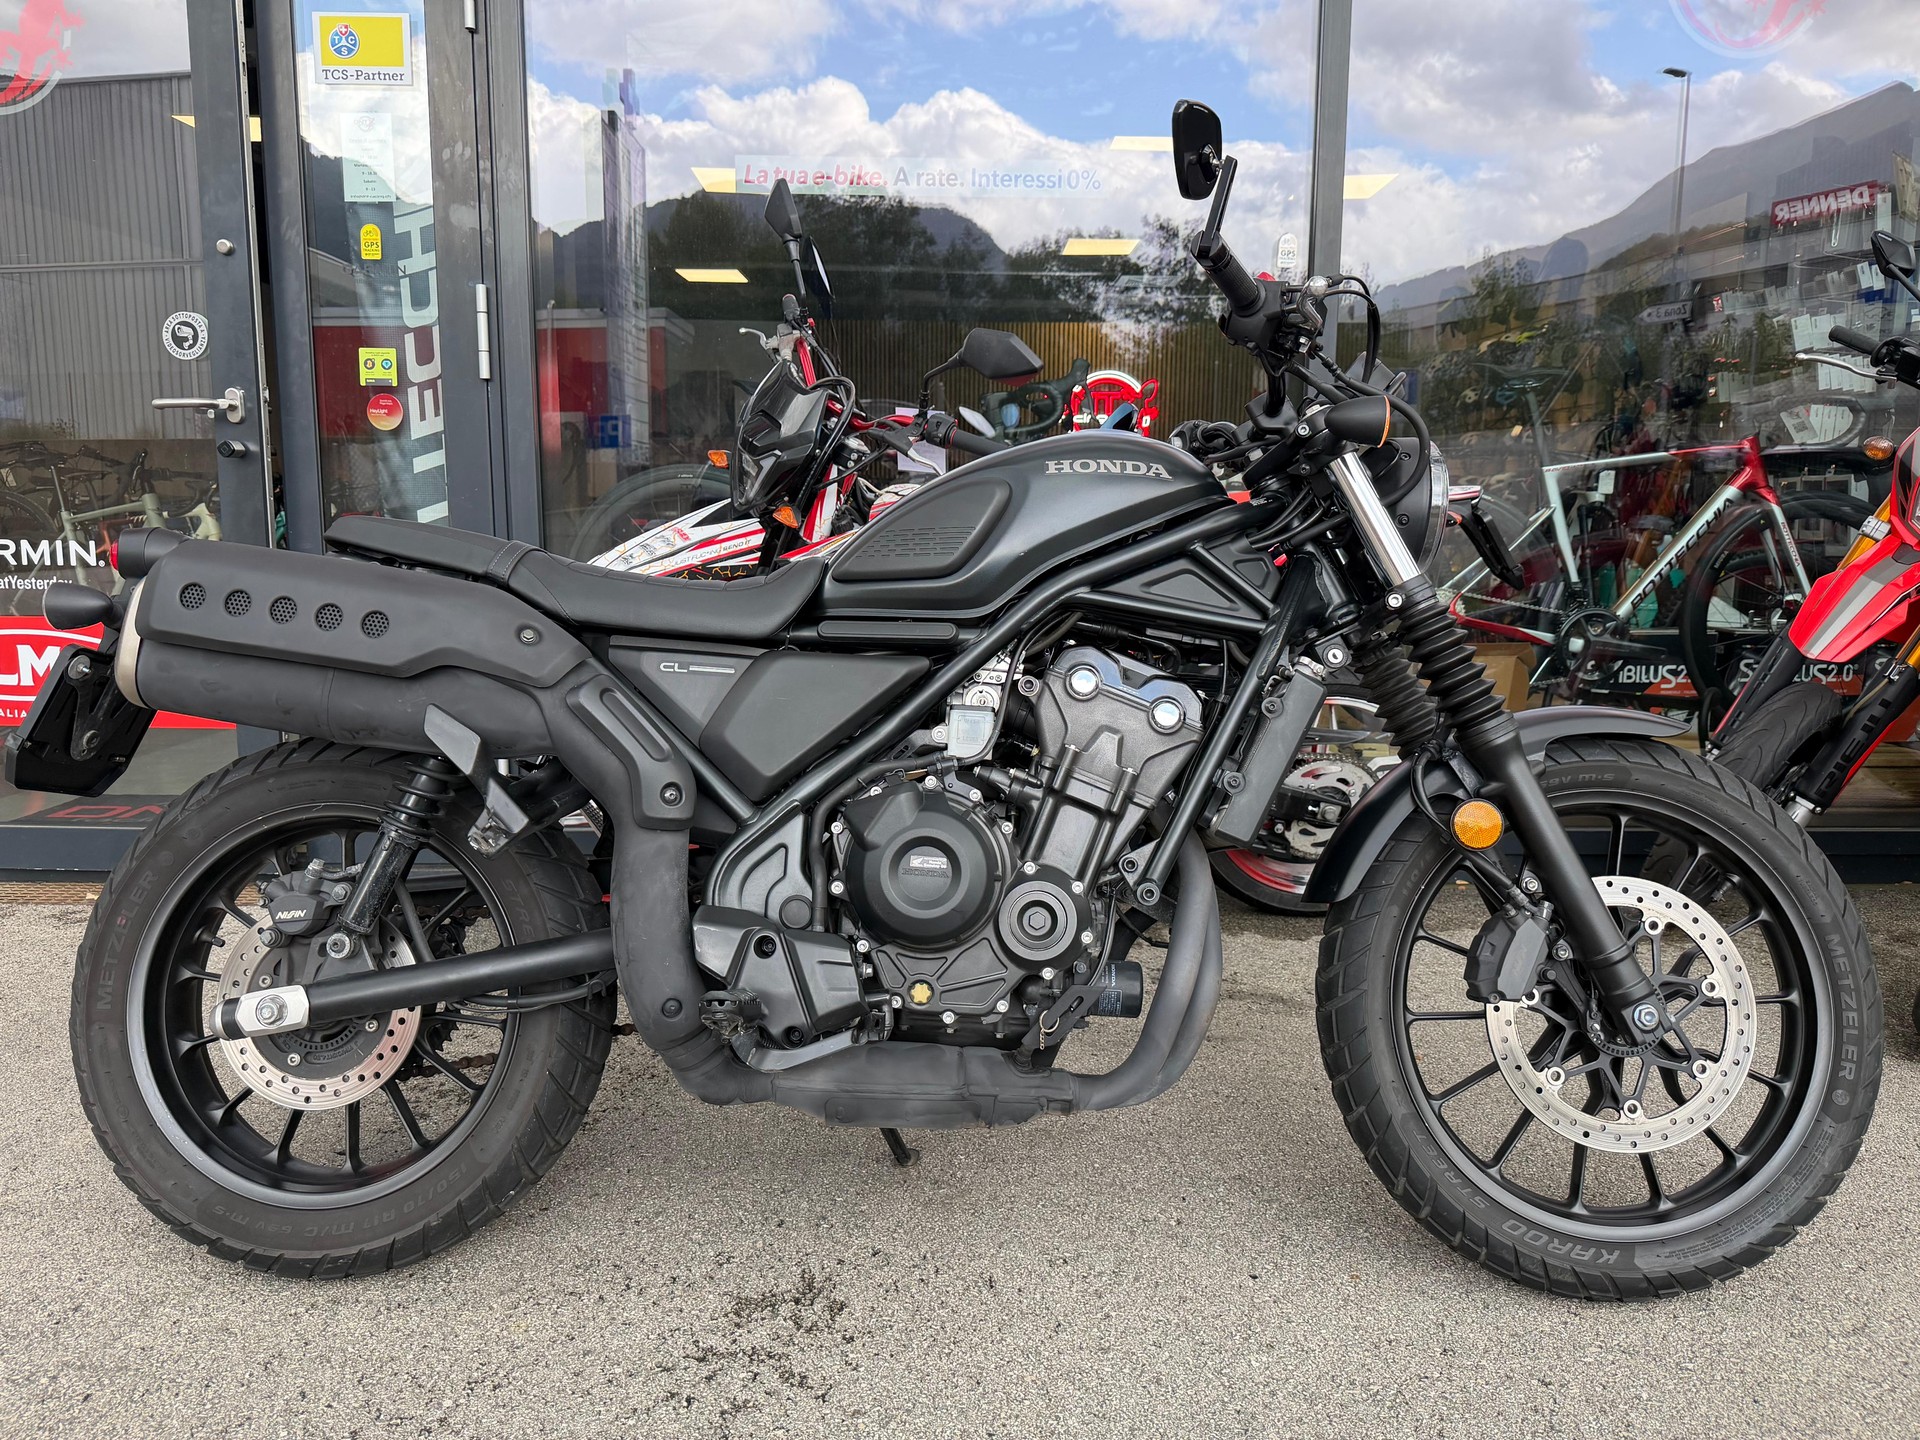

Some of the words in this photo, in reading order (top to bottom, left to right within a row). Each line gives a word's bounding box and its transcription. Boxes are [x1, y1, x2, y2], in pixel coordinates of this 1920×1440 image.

[322, 69, 405, 81] TCS-Partner
[744, 164, 769, 184] La
[812, 164, 889, 187] e-bike.
[893, 166, 910, 187] A
[916, 169, 965, 187] rate.
[971, 167, 1062, 189] Interessi
[1066, 169, 1101, 190] 0%
[164, 336, 206, 358] VIDEOSORVEGLIANZA
[1045, 459, 1173, 479] HONDA
[1630, 497, 1735, 611] BOTTECCHIA
[1780, 521, 1801, 568] BOTTECCHIA
[0, 575, 73, 590] atYesterd
[659, 662, 688, 673] CL
[275, 909, 307, 920] NISSIN
[96, 870, 159, 1010] METZELER
[1824, 933, 1859, 1081] METZELER
[1411, 1130, 1491, 1210] STREET
[1501, 1218, 1620, 1265] KAROO
